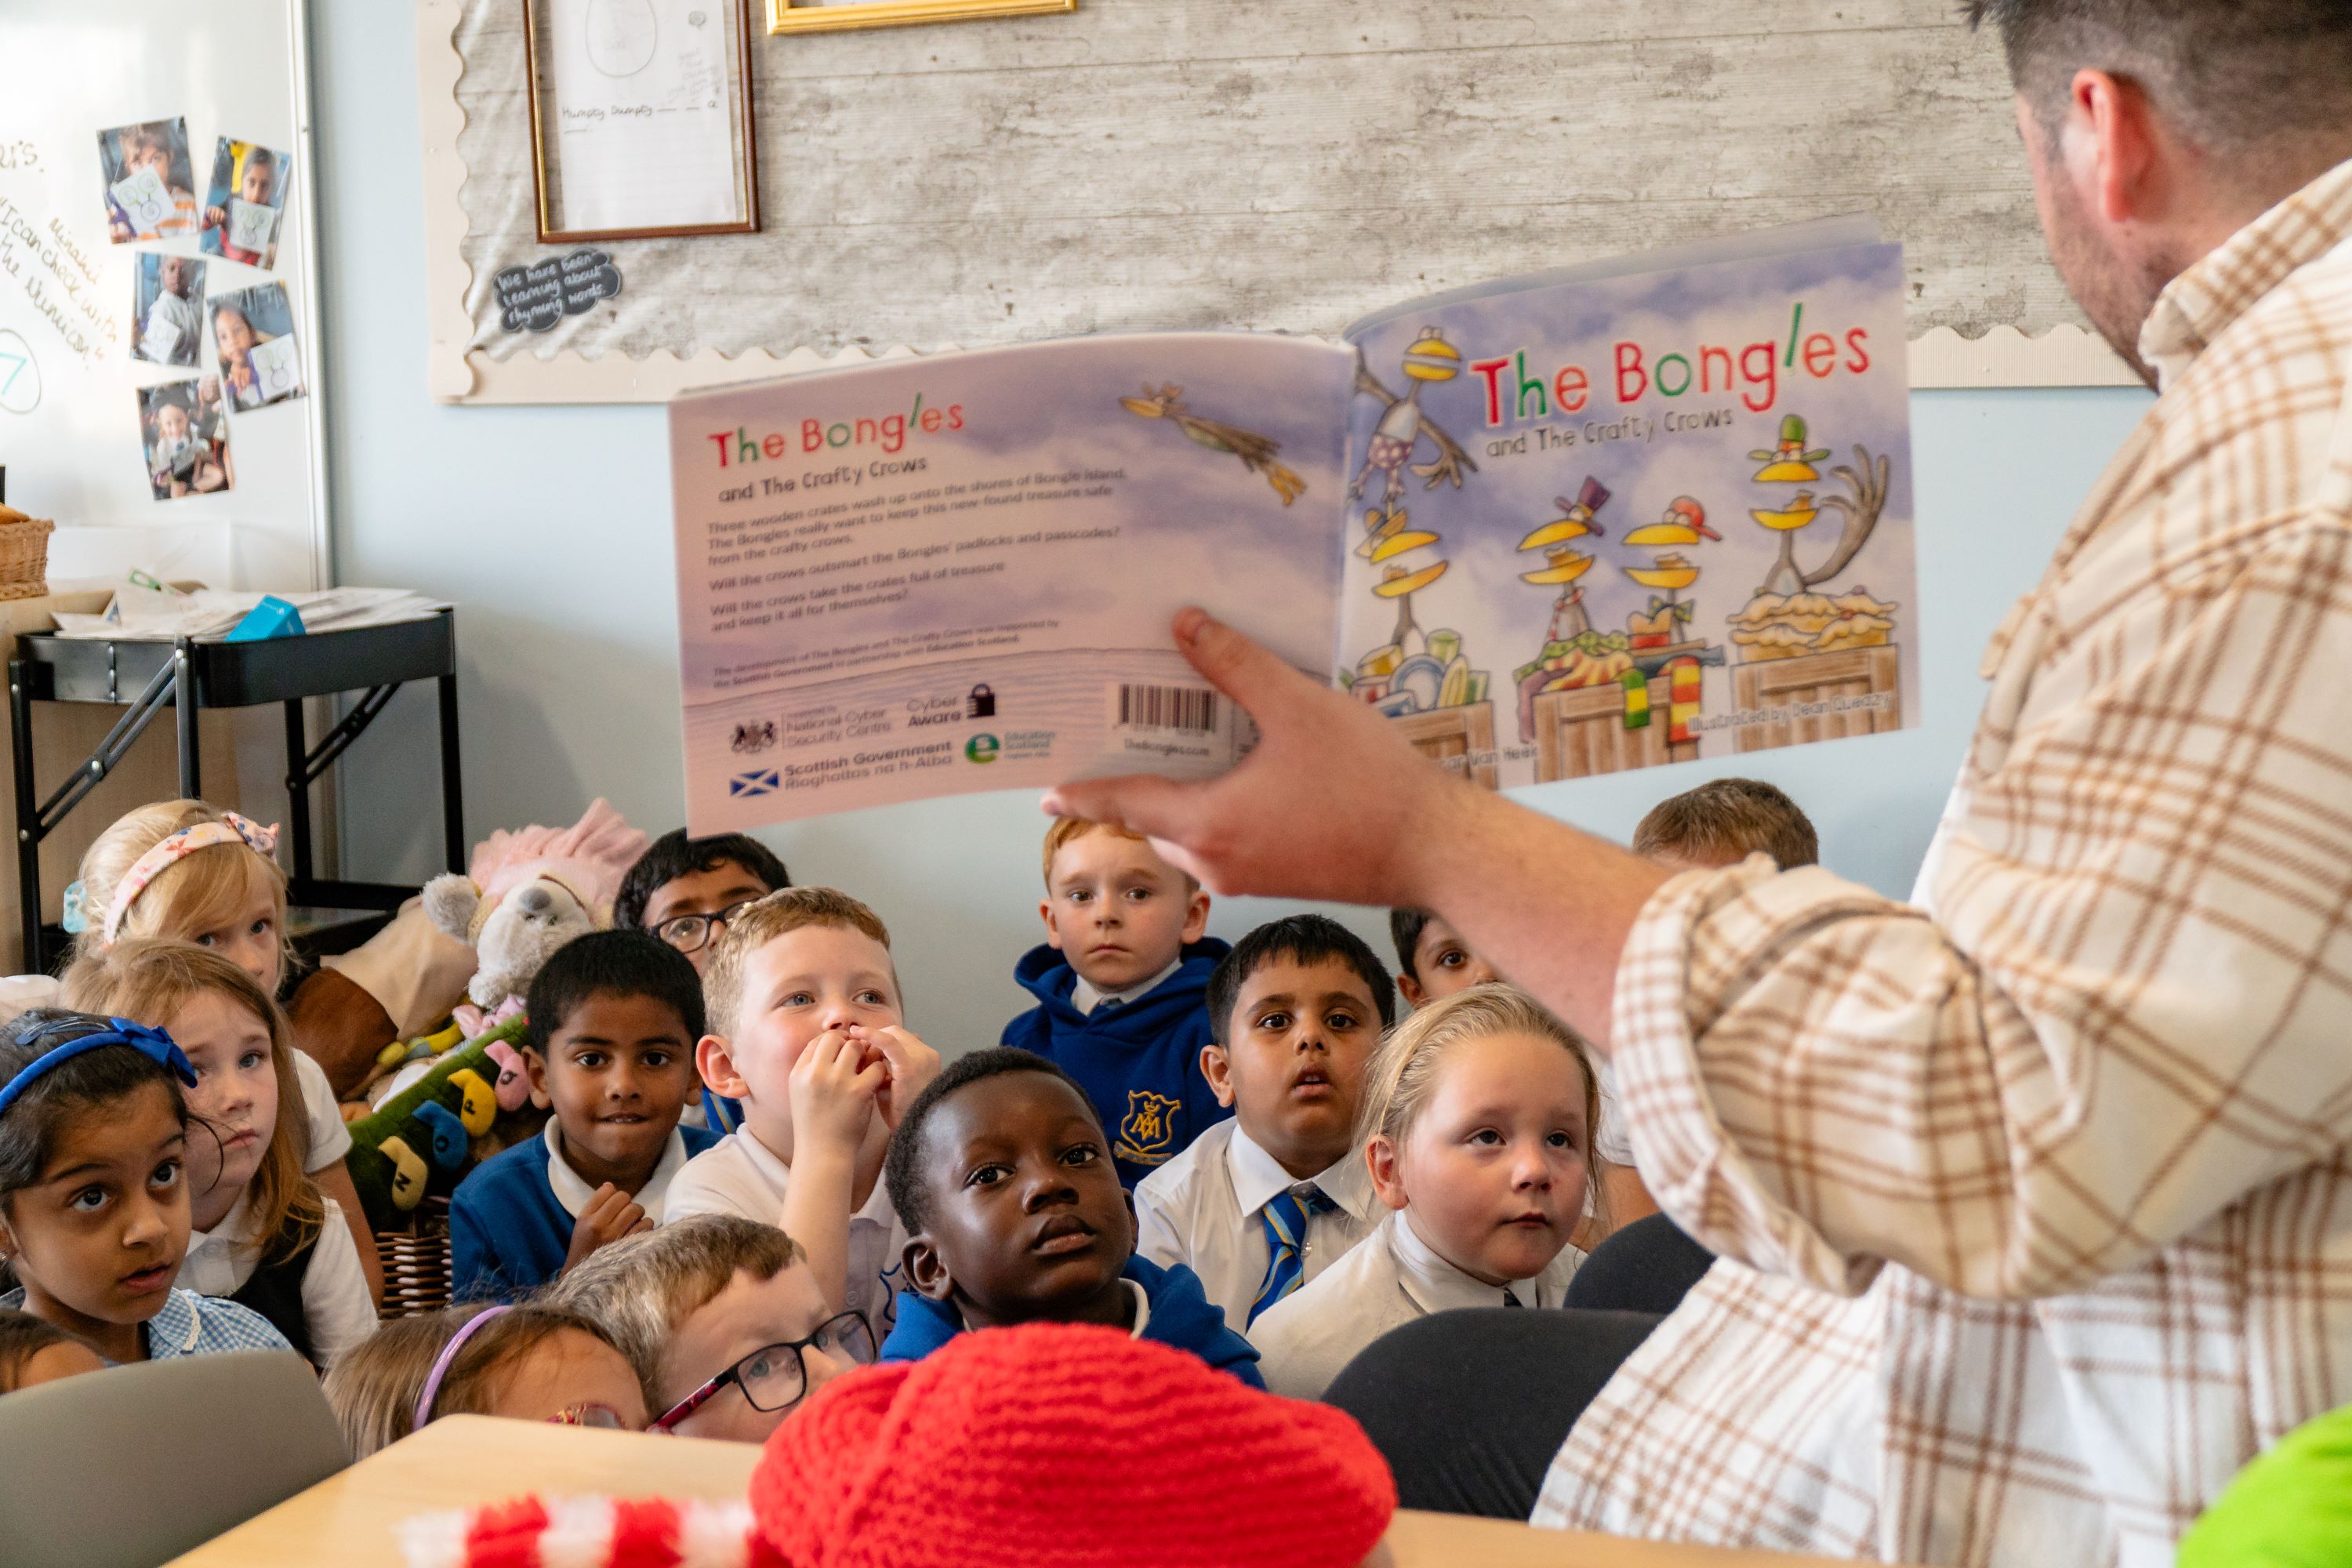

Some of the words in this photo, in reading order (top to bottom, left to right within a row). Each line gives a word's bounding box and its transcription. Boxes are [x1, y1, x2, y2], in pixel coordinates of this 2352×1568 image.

[561, 106, 604, 120] Humpty
[498, 274, 522, 291] We
[526, 264, 557, 282] have
[561, 255, 592, 272] been
[564, 265, 602, 285] about
[1469, 350, 1589, 426] The
[1613, 302, 1871, 413] Bongles
[708, 426, 786, 468] The
[801, 392, 964, 454] Bongles
[1486, 433, 1527, 459] and
[1535, 425, 1577, 452] The
[1584, 416, 1656, 444] Crafty
[1663, 407, 1734, 434] Crows
[718, 481, 754, 503] and
[760, 475, 796, 496] The
[802, 466, 862, 487] Crafty
[869, 457, 928, 478] Crows
[709, 521, 746, 534] Three
[750, 511, 804, 527] wooden
[808, 504, 848, 517] crates
[853, 496, 885, 509] wash
[889, 495, 906, 505] up
[909, 488, 941, 501] onto
[944, 483, 966, 495] the
[971, 478, 1013, 492] shores
[1016, 475, 1030, 486] of
[1034, 470, 1081, 485] Bongle
[709, 537, 733, 549] The
[737, 528, 789, 545] Bongles
[794, 521, 829, 535] really
[834, 515, 866, 528] want
[870, 513, 883, 523] to
[887, 508, 919, 520] keep
[923, 503, 946, 514] this
[1027, 488, 1080, 501] treasure
[1086, 484, 1112, 496] safe
[709, 553, 740, 565] from
[744, 549, 766, 561] the
[770, 541, 808, 556] crafty
[811, 534, 853, 549] crows.
[709, 577, 737, 590] Will
[740, 574, 762, 586] the
[765, 568, 805, 582] crows
[809, 557, 869, 575] outsmart
[872, 552, 893, 564] the
[955, 535, 1013, 552] padlocks
[1017, 532, 1042, 544] and
[1045, 526, 1120, 543] passcodes?
[710, 604, 737, 616] Will
[741, 600, 763, 612] the
[766, 593, 806, 607] crows
[809, 587, 838, 601] take
[841, 583, 862, 594] the
[866, 576, 906, 590] crates
[909, 570, 931, 583] full
[934, 567, 947, 579] of
[950, 561, 1005, 577] treasure
[711, 619, 735, 633] and
[739, 614, 771, 627] keep
[775, 611, 784, 621] it
[787, 607, 803, 619] all
[806, 605, 825, 616] for
[829, 590, 907, 612] themselves?
[786, 715, 841, 733] National
[845, 709, 886, 724] Cyber
[906, 695, 958, 713] Cyber
[907, 710, 961, 728] Aware
[787, 729, 841, 746] Security
[846, 722, 891, 738] Centre
[785, 757, 848, 777] Scottish
[853, 741, 952, 764] Government
